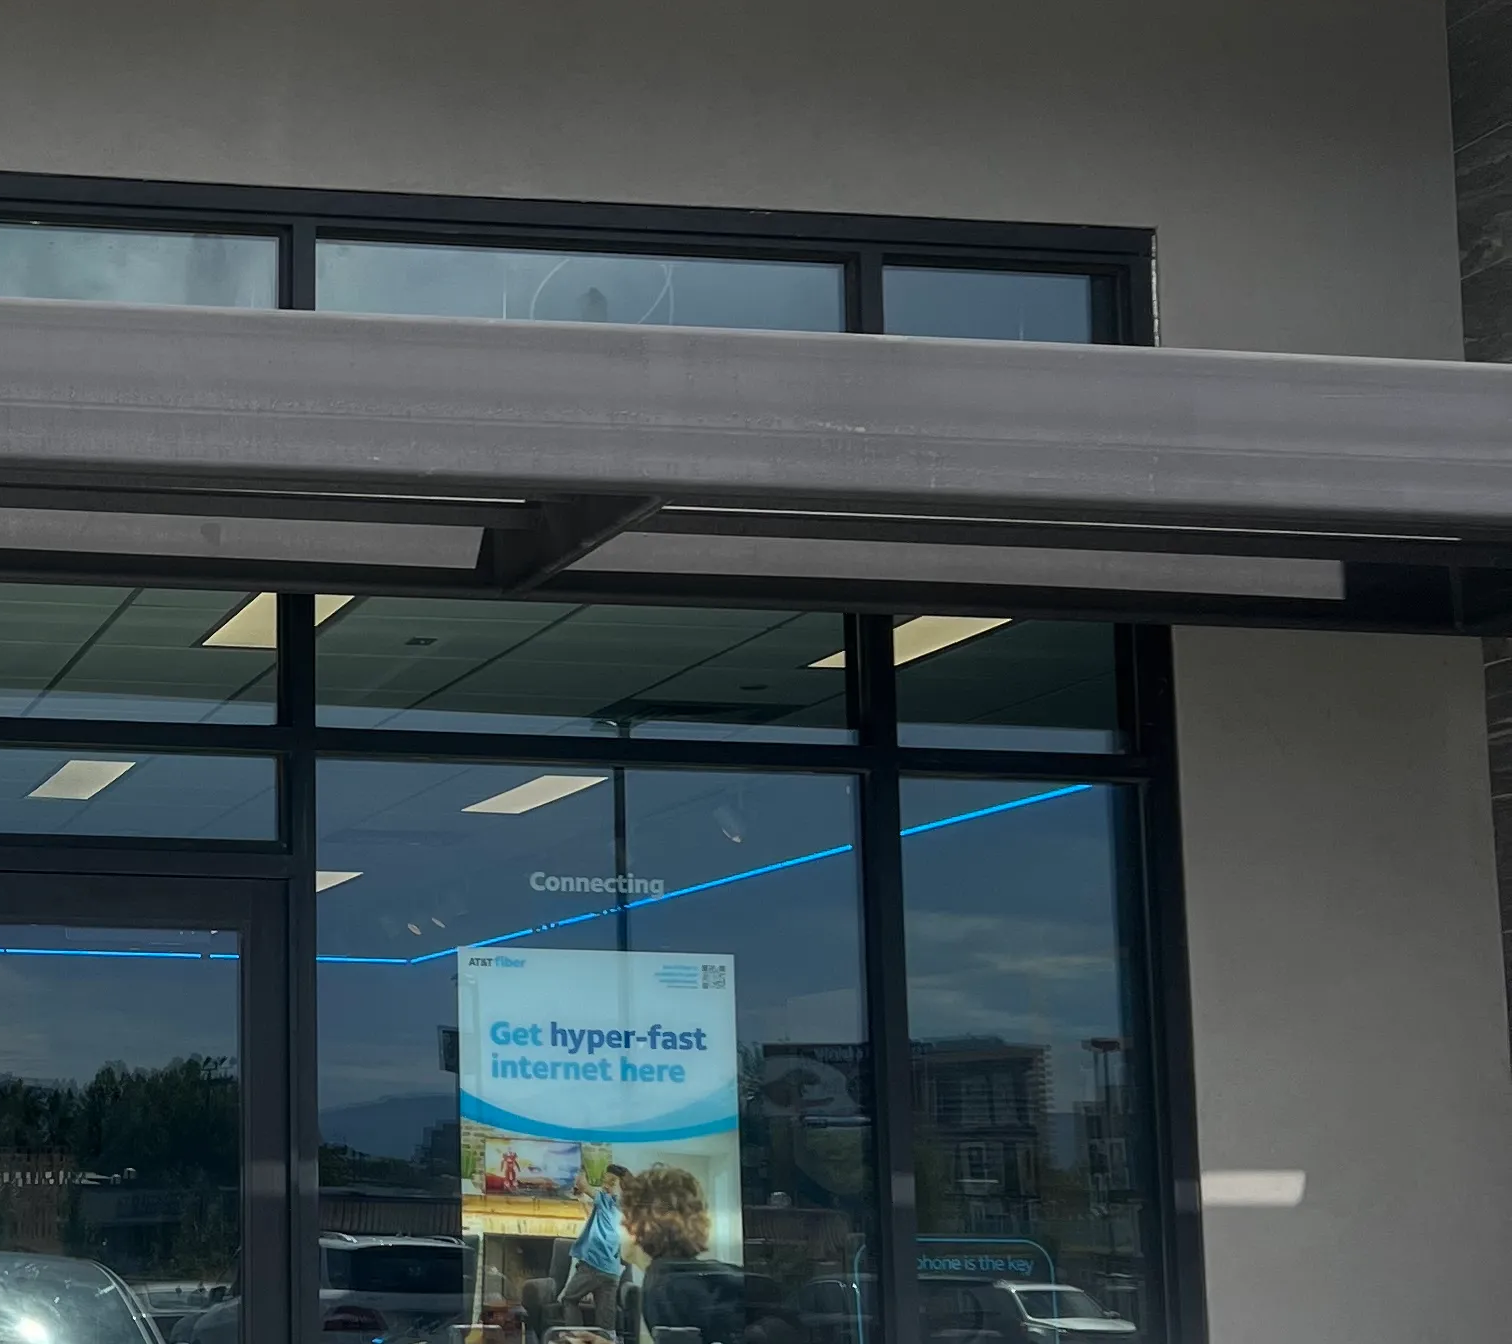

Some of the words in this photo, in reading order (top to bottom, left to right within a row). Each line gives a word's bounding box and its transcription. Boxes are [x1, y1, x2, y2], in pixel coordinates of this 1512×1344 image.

[529, 871, 665, 899] Connecting
[468, 957, 493, 967] AT&T
[495, 956, 526, 968] fiber
[489, 1021, 542, 1046] Get
[550, 1021, 707, 1055] hyper-fast
[490, 1053, 612, 1082] internet
[620, 1056, 686, 1083] here
[964, 1255, 976, 1271] is
[978, 1255, 1005, 1272] the
[1007, 1256, 1035, 1276] key
